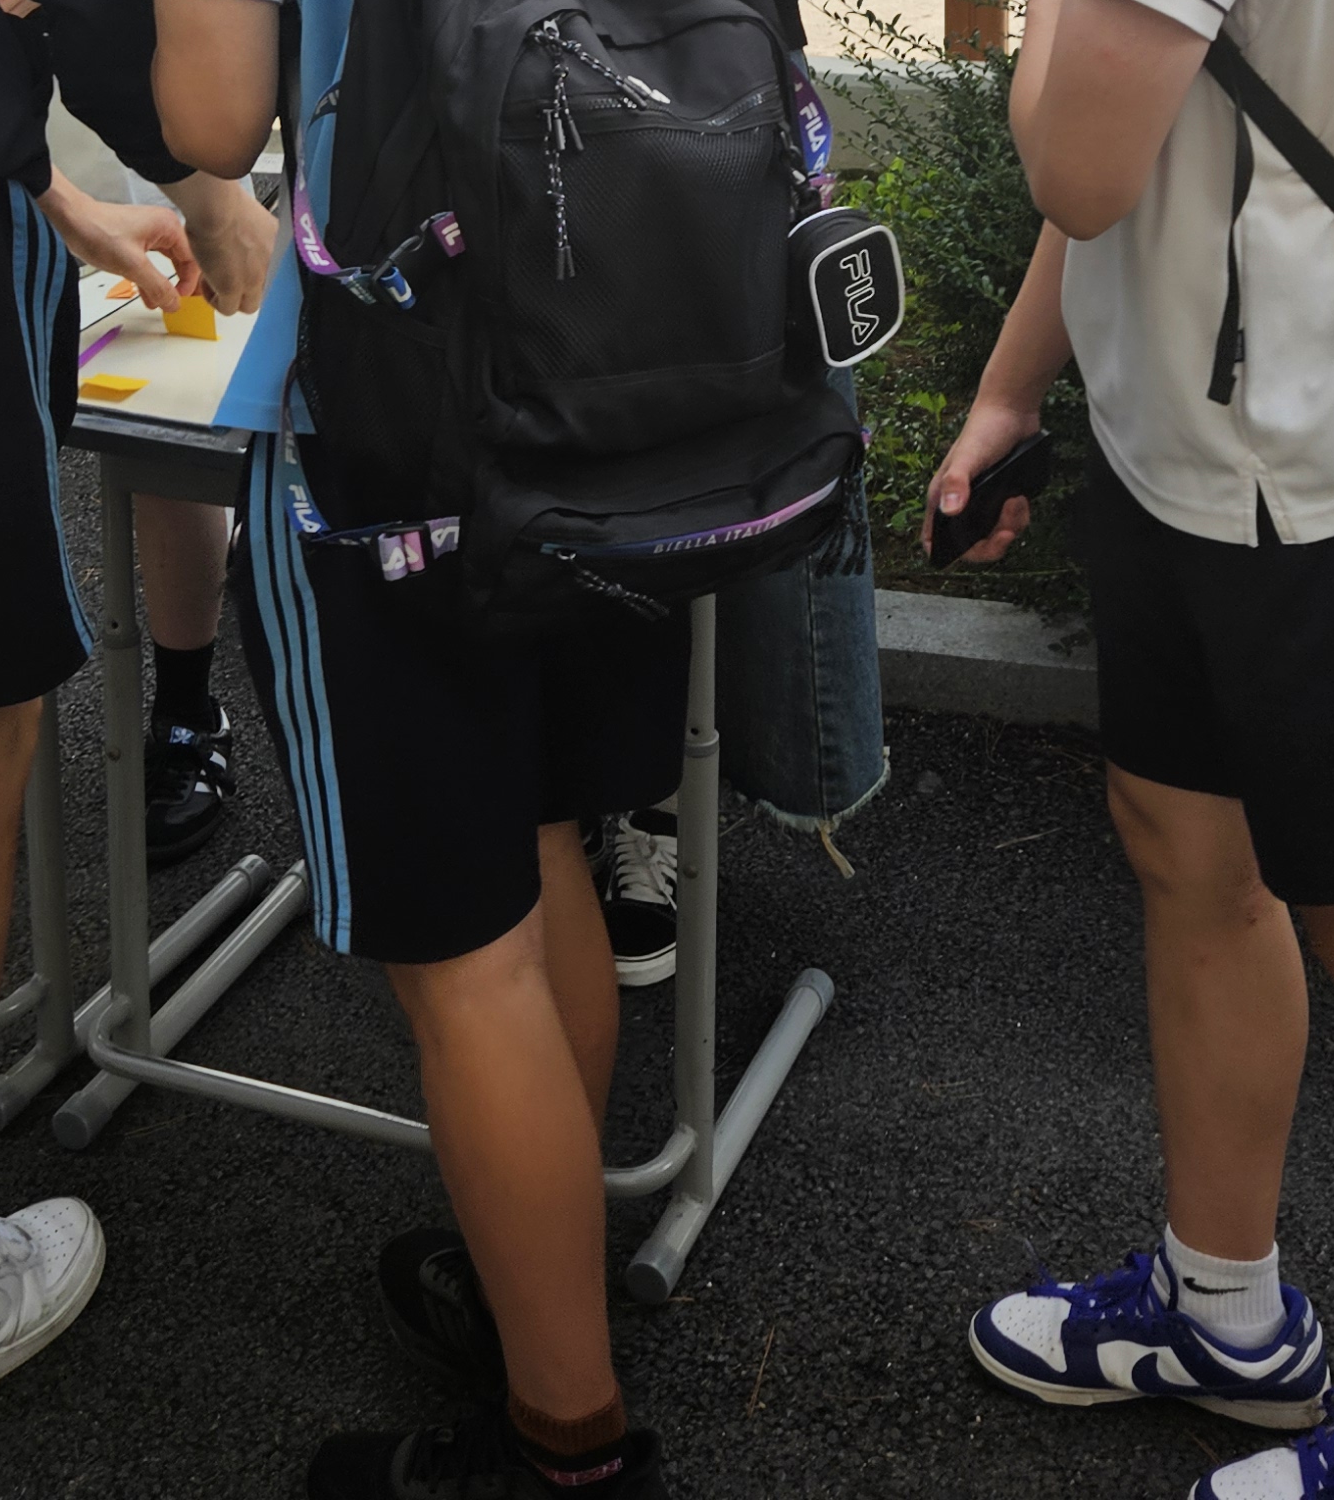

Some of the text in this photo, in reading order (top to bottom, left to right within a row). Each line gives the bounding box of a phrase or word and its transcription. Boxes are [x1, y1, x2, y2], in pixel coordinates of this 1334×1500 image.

[799, 102, 827, 153] FILA
[300, 213, 330, 266] FILA
[840, 248, 880, 346] FILA
[289, 484, 322, 533] FILA
[653, 518, 781, 554] BIELLA ITALIA
